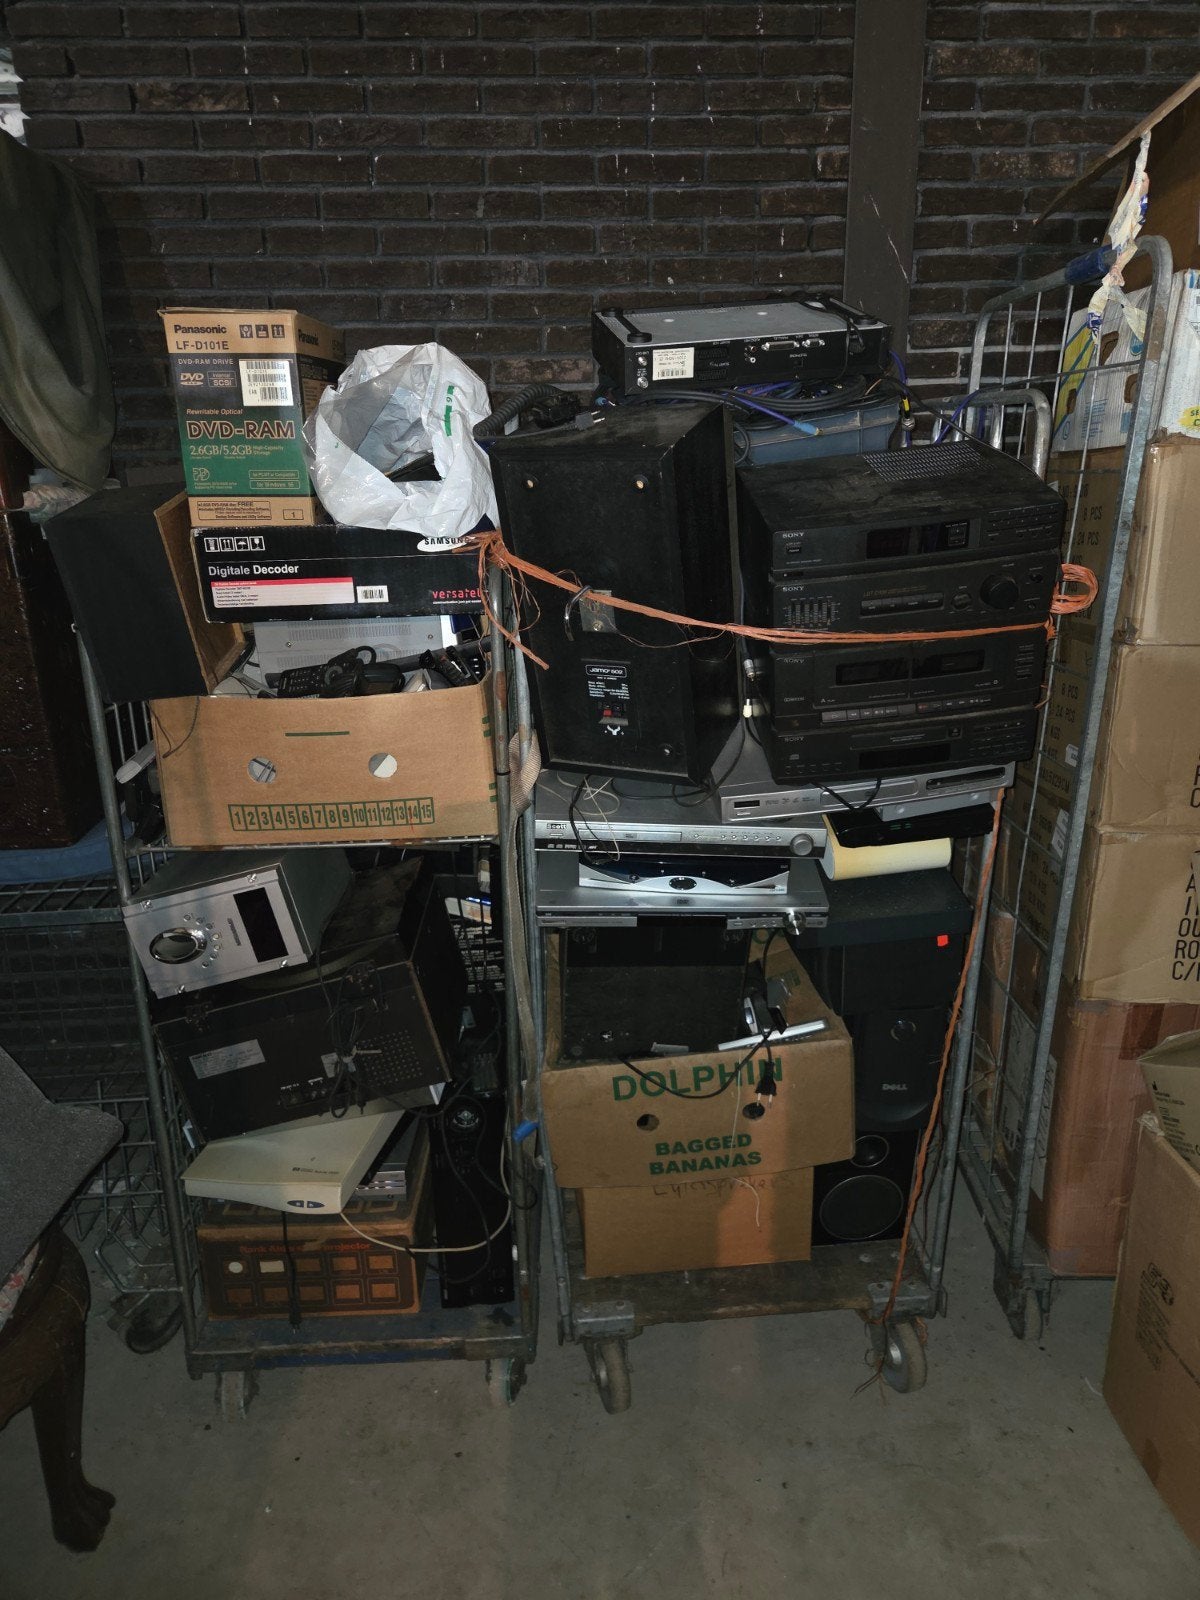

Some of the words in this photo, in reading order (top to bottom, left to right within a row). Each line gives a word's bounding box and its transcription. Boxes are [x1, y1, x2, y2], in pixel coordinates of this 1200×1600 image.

[174, 325, 227, 334] Panasonic
[176, 341, 229, 350] LF-D101E
[180, 373, 204, 381] DVD
[186, 421, 296, 439] DVD-RAM
[189, 445, 252, 456] 2.6GB/5.2GB
[208, 566, 250, 578] Digitale
[253, 564, 299, 574] Decoder
[432, 588, 481, 598] versatel
[234, 811, 242, 825] 1
[249, 811, 256, 826] 2
[261, 811, 270, 826] 3
[275, 811, 283, 825] 4
[288, 810, 296, 825] 5
[302, 810, 310, 824] 6
[315, 809, 322, 824] 7
[329, 809, 337, 824] 8
[342, 809, 350, 823] 9
[353, 808, 365, 822] 10
[367, 808, 378, 822] 11
[381, 807, 392, 821] 12
[394, 806, 406, 820] 13
[421, 804, 432, 819] 15
[612, 1057, 783, 1101] DOLPHIN
[882, 1083, 908, 1091] DELL
[655, 1133, 752, 1156] BAGGED
[649, 1151, 762, 1175] BANANAS
